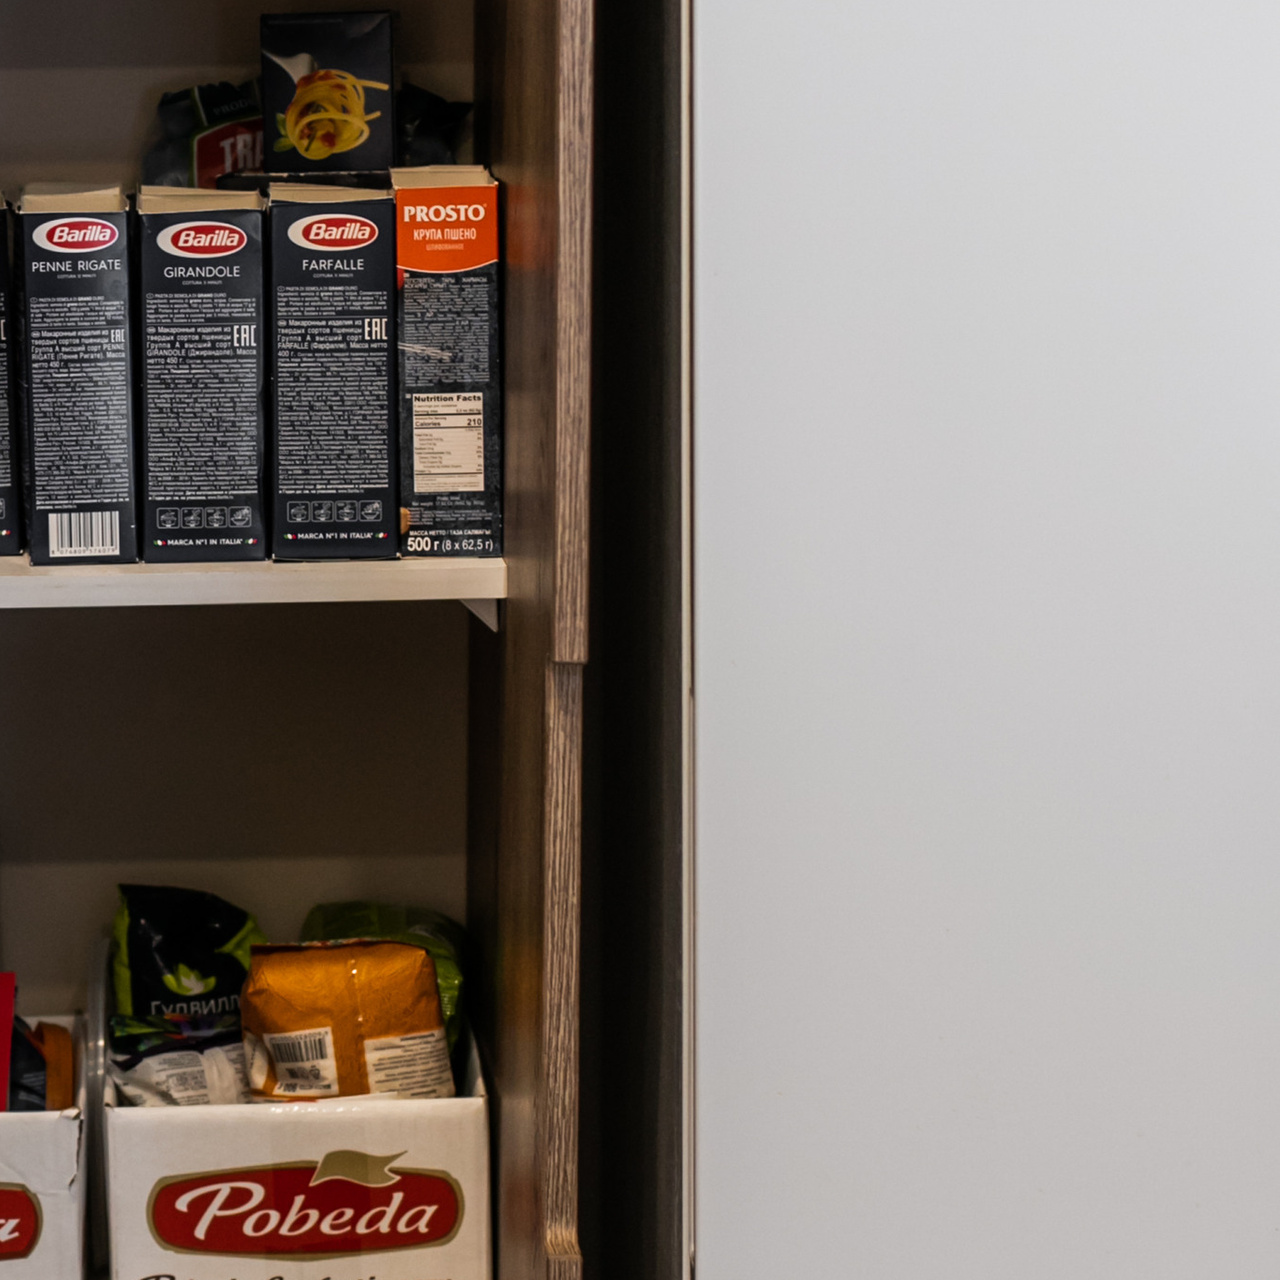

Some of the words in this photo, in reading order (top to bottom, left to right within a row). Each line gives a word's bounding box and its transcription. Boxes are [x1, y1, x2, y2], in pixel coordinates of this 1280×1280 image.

[403, 204, 485, 222] PROSTO
[52, 225, 111, 243] Barilla
[177, 230, 240, 247] Barilla
[309, 222, 371, 240] Barilla
[413, 228, 443, 241] КРУПА
[444, 227, 477, 240] ПШЕНО
[32, 260, 72, 272] PENNE
[78, 259, 122, 271] RIGATE
[164, 266, 240, 278] GIRANDOLE
[302, 258, 364, 271] FARFALLE
[467, 418, 482, 426] 210
[407, 536, 432, 552] 500
[442, 540, 452, 552] (8
[462, 539, 484, 551] 62,5
[174, 1180, 439, 1241] Pobeda
